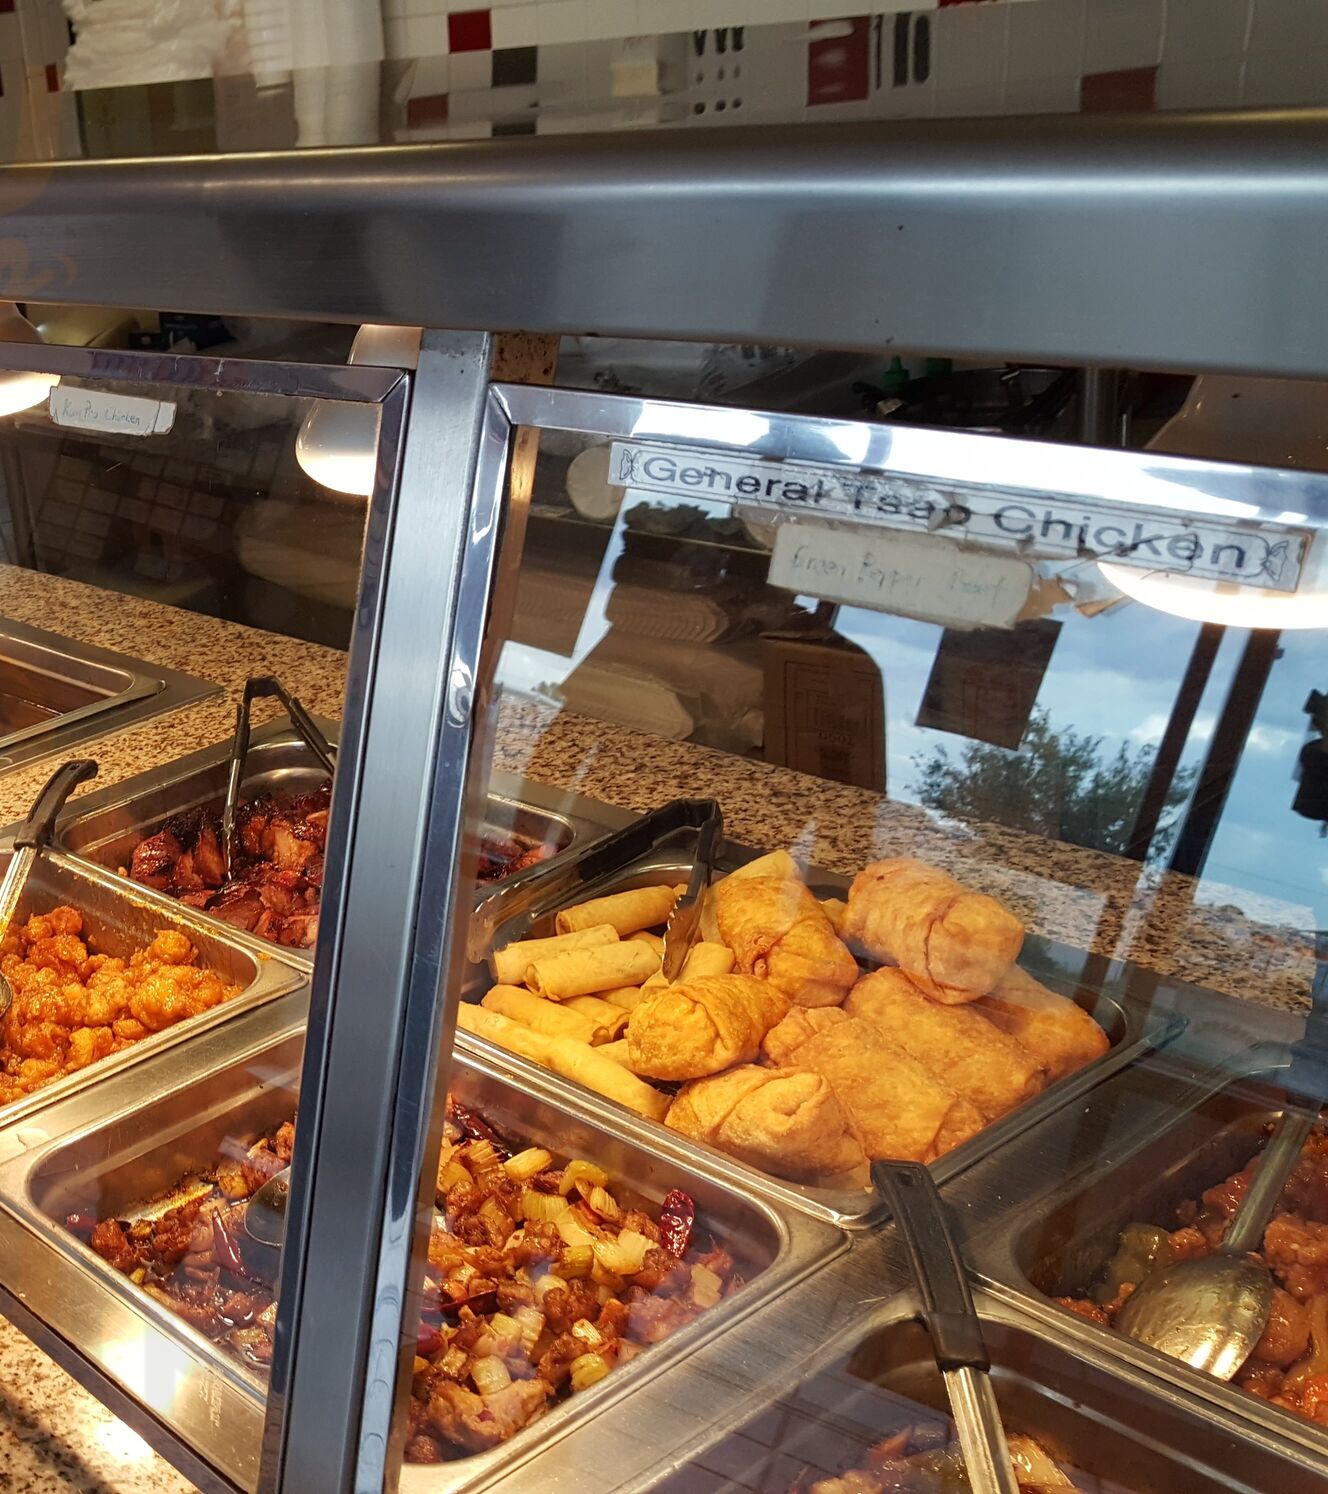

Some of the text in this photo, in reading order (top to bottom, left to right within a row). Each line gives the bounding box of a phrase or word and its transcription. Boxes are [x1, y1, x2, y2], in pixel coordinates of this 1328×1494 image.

[643, 456, 825, 506] General
[994, 504, 1246, 569] Chicken
[793, 545, 847, 577] Green
[858, 551, 922, 590] Pepper
